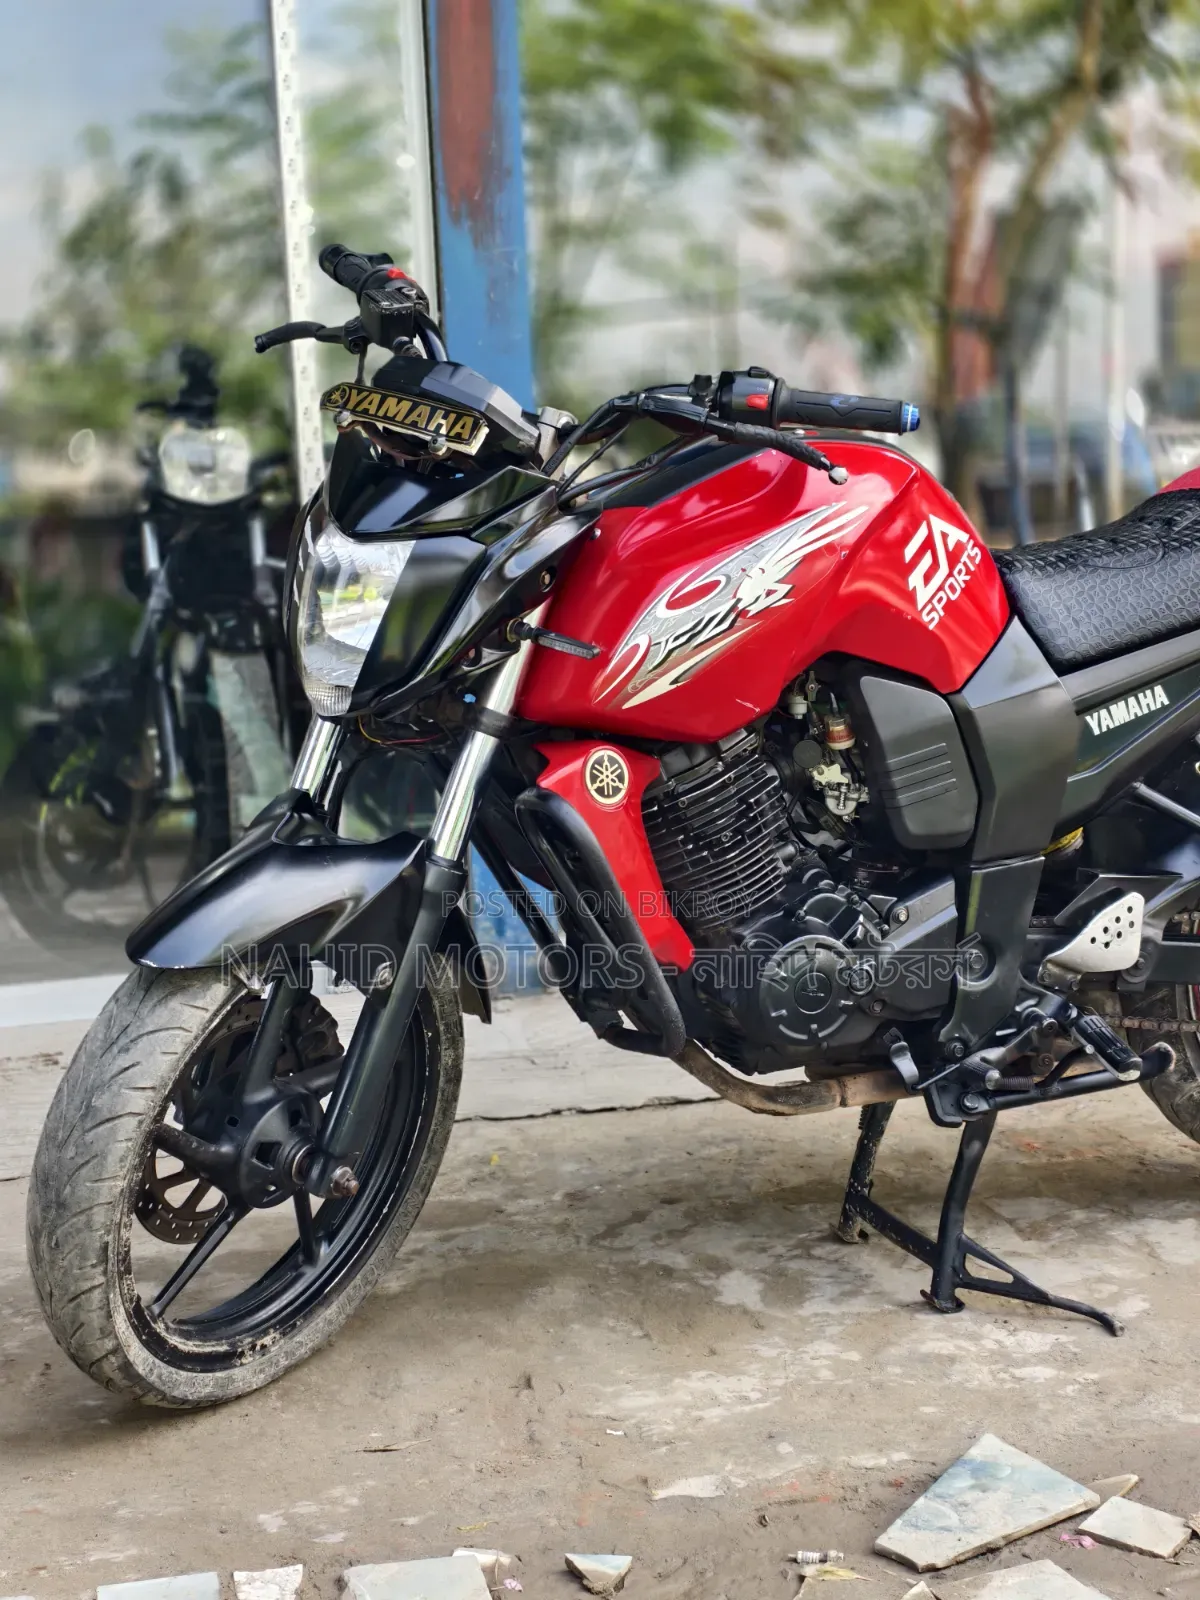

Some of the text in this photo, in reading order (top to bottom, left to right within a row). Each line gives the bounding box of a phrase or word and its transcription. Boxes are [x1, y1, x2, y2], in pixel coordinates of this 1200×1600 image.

[345, 388, 475, 440] YAMAHA
[921, 539, 982, 630] SPORTS
[1085, 685, 1170, 736] YAMAHA
